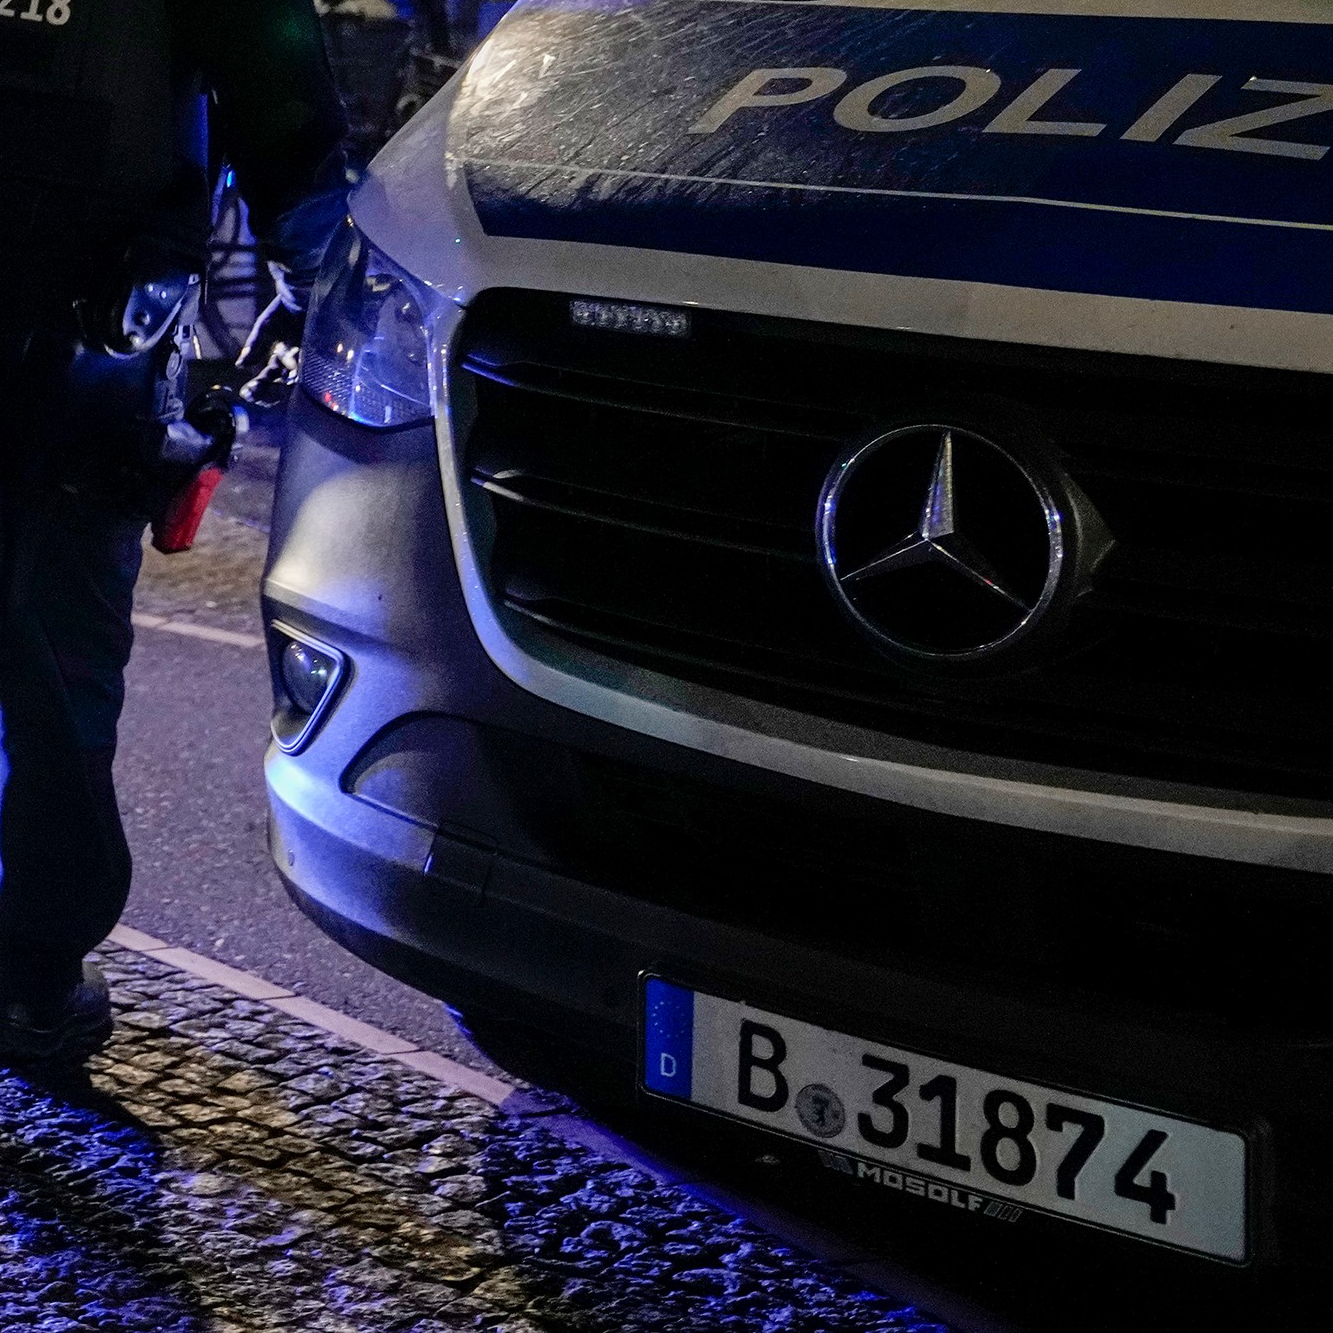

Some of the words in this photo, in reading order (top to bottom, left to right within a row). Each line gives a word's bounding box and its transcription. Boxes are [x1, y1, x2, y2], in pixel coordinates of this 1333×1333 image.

[687, 65, 1333, 161] POLIZ
[660, 1053, 677, 1077] D
[736, 1018, 789, 1114] B
[856, 1053, 1176, 1225] 31874
[856, 1161, 985, 1212] MOSOLF
